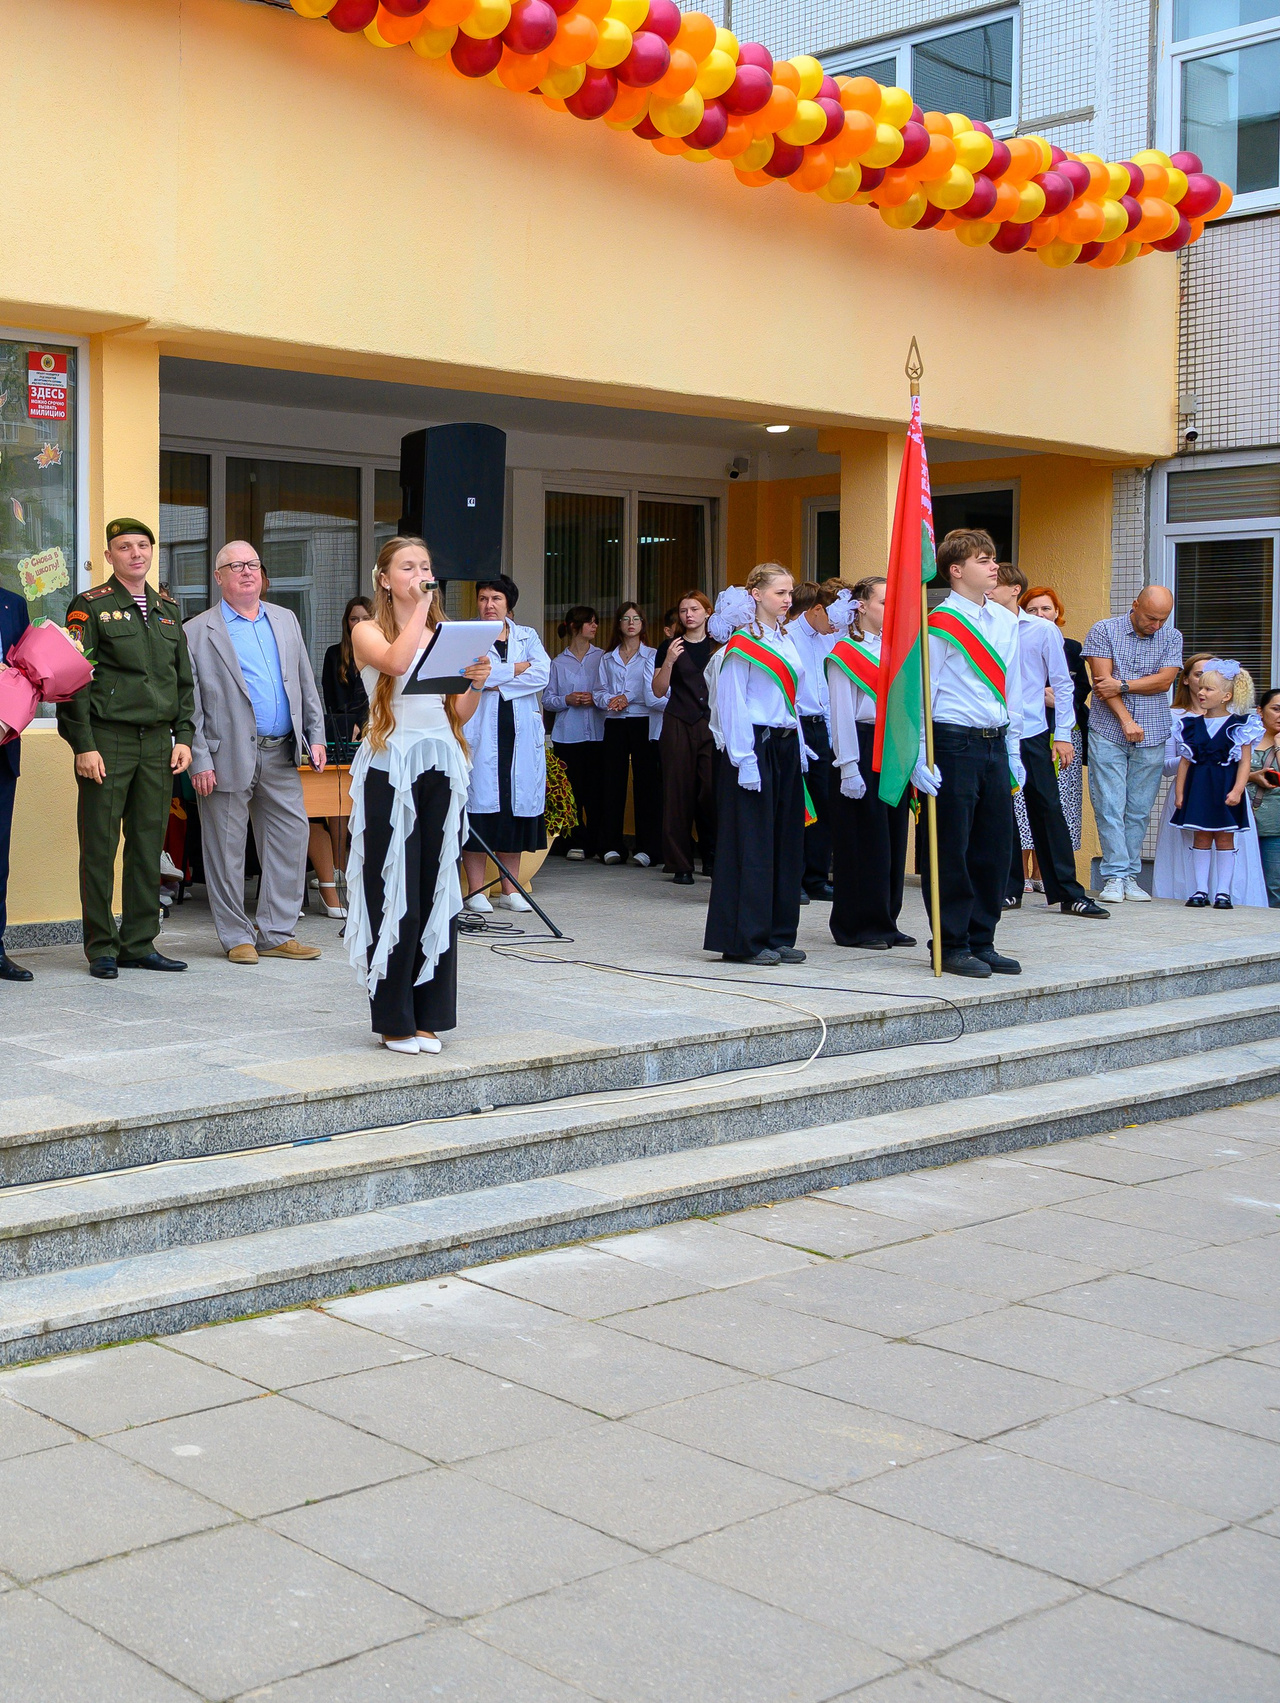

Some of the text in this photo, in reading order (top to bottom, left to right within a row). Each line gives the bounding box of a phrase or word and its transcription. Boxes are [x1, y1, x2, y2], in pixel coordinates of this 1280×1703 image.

[30, 386, 65, 400] ЗДЕСЬ
[30, 408, 65, 418] МИЛИЦИЮ
[30, 551, 59, 568] Снова в
[34, 559, 60, 577] школу!
